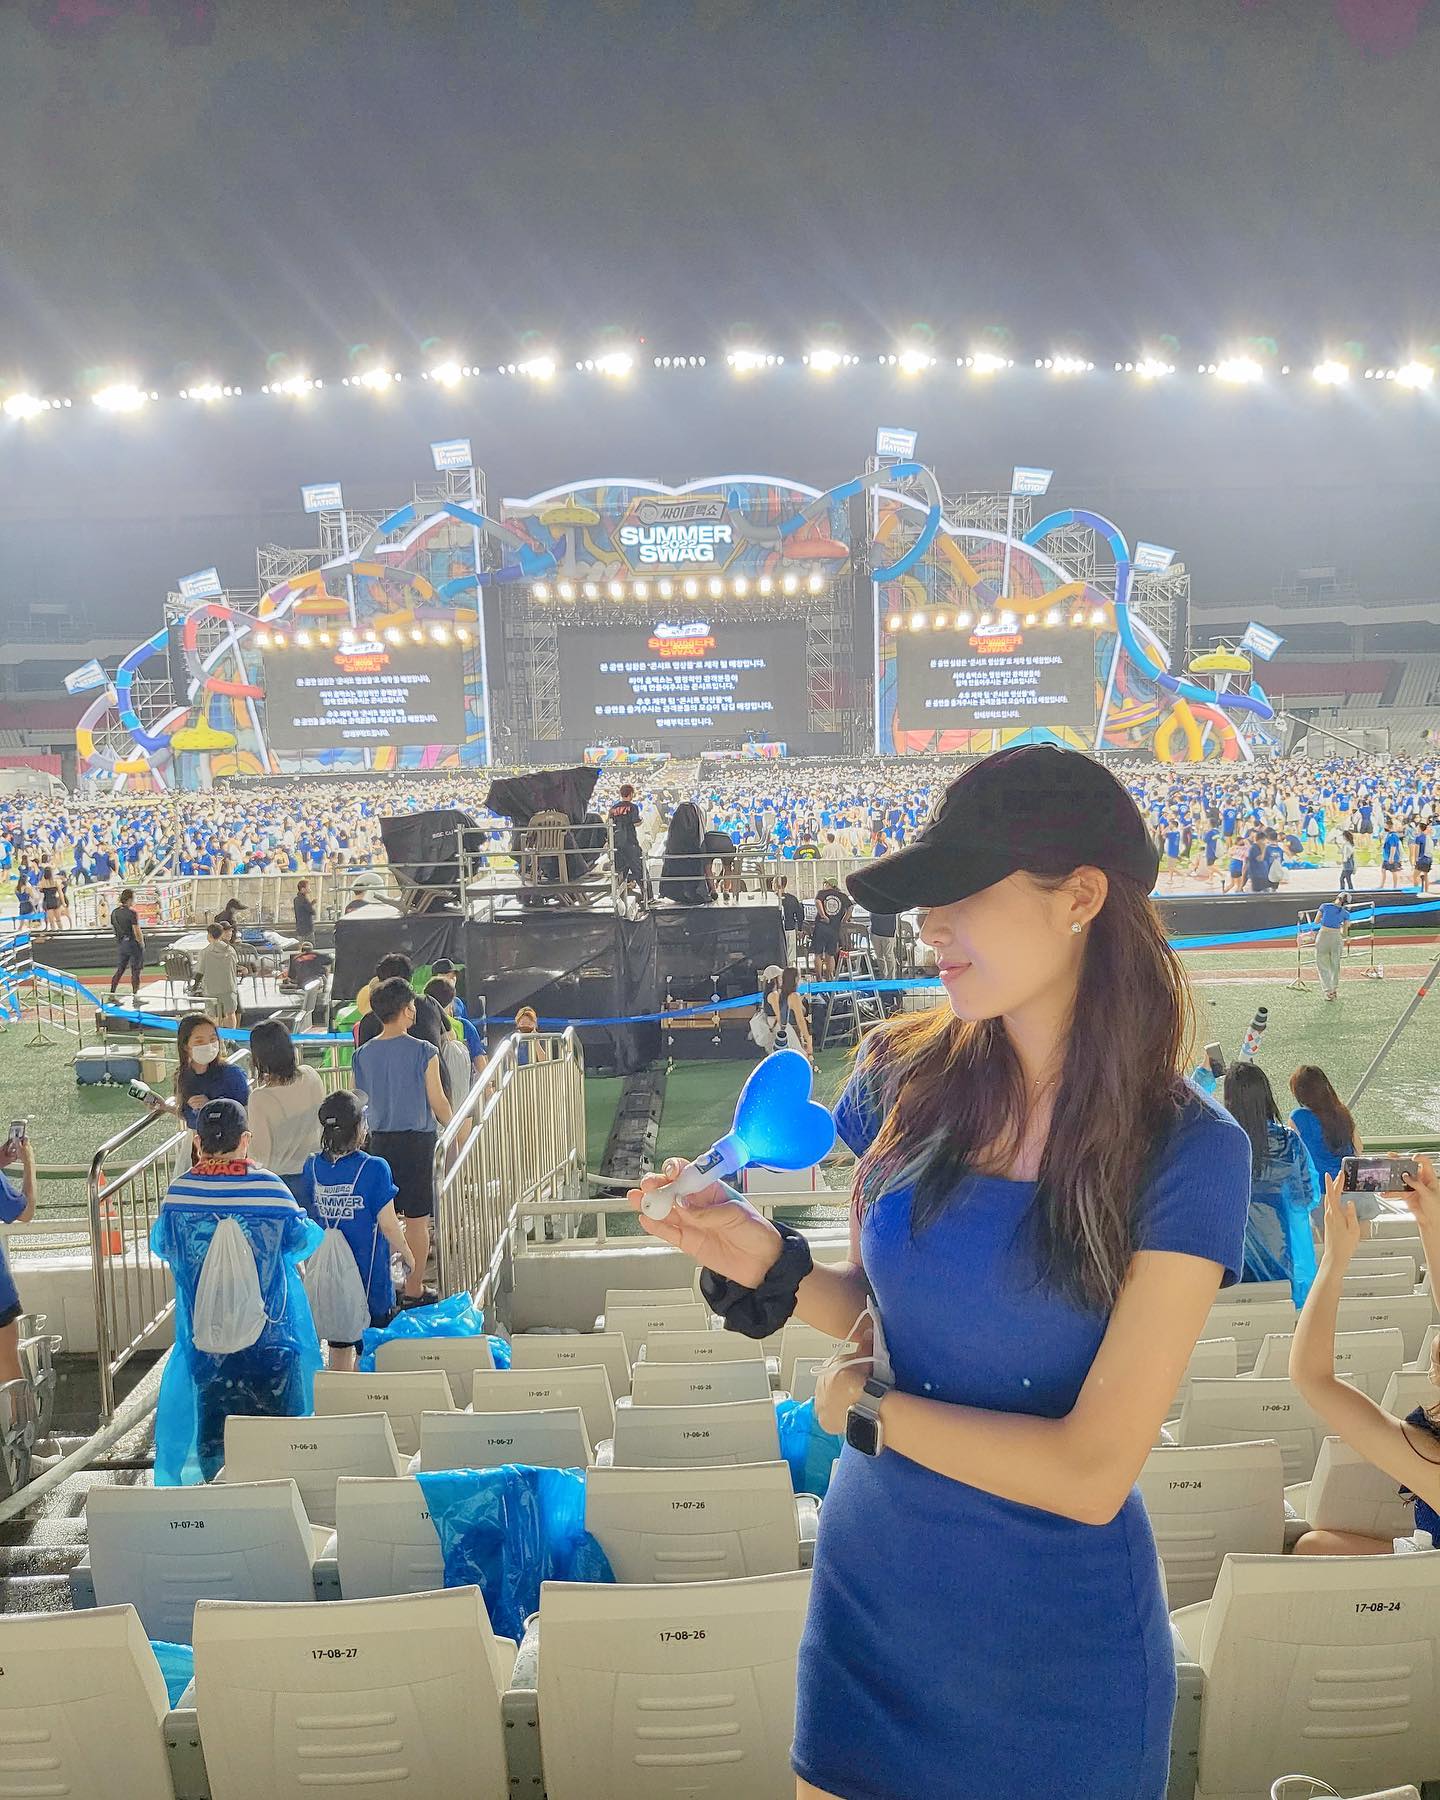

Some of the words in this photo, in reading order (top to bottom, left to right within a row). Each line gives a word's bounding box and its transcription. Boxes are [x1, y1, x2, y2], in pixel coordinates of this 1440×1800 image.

[620, 525, 732, 545] SUMMER
[661, 540, 697, 549] 2022
[640, 544, 715, 562] SWAG
[648, 637, 715, 648] SUMMER
[1169, 1481, 1202, 1489] 17-07-24
[671, 1501, 706, 1509] 17-07-26
[169, 1520, 205, 1529] 17-07-28
[1355, 1602, 1401, 1613] 17-08-24
[659, 1629, 706, 1642] 17-08-26
[311, 1648, 358, 1659] 17-08-27
